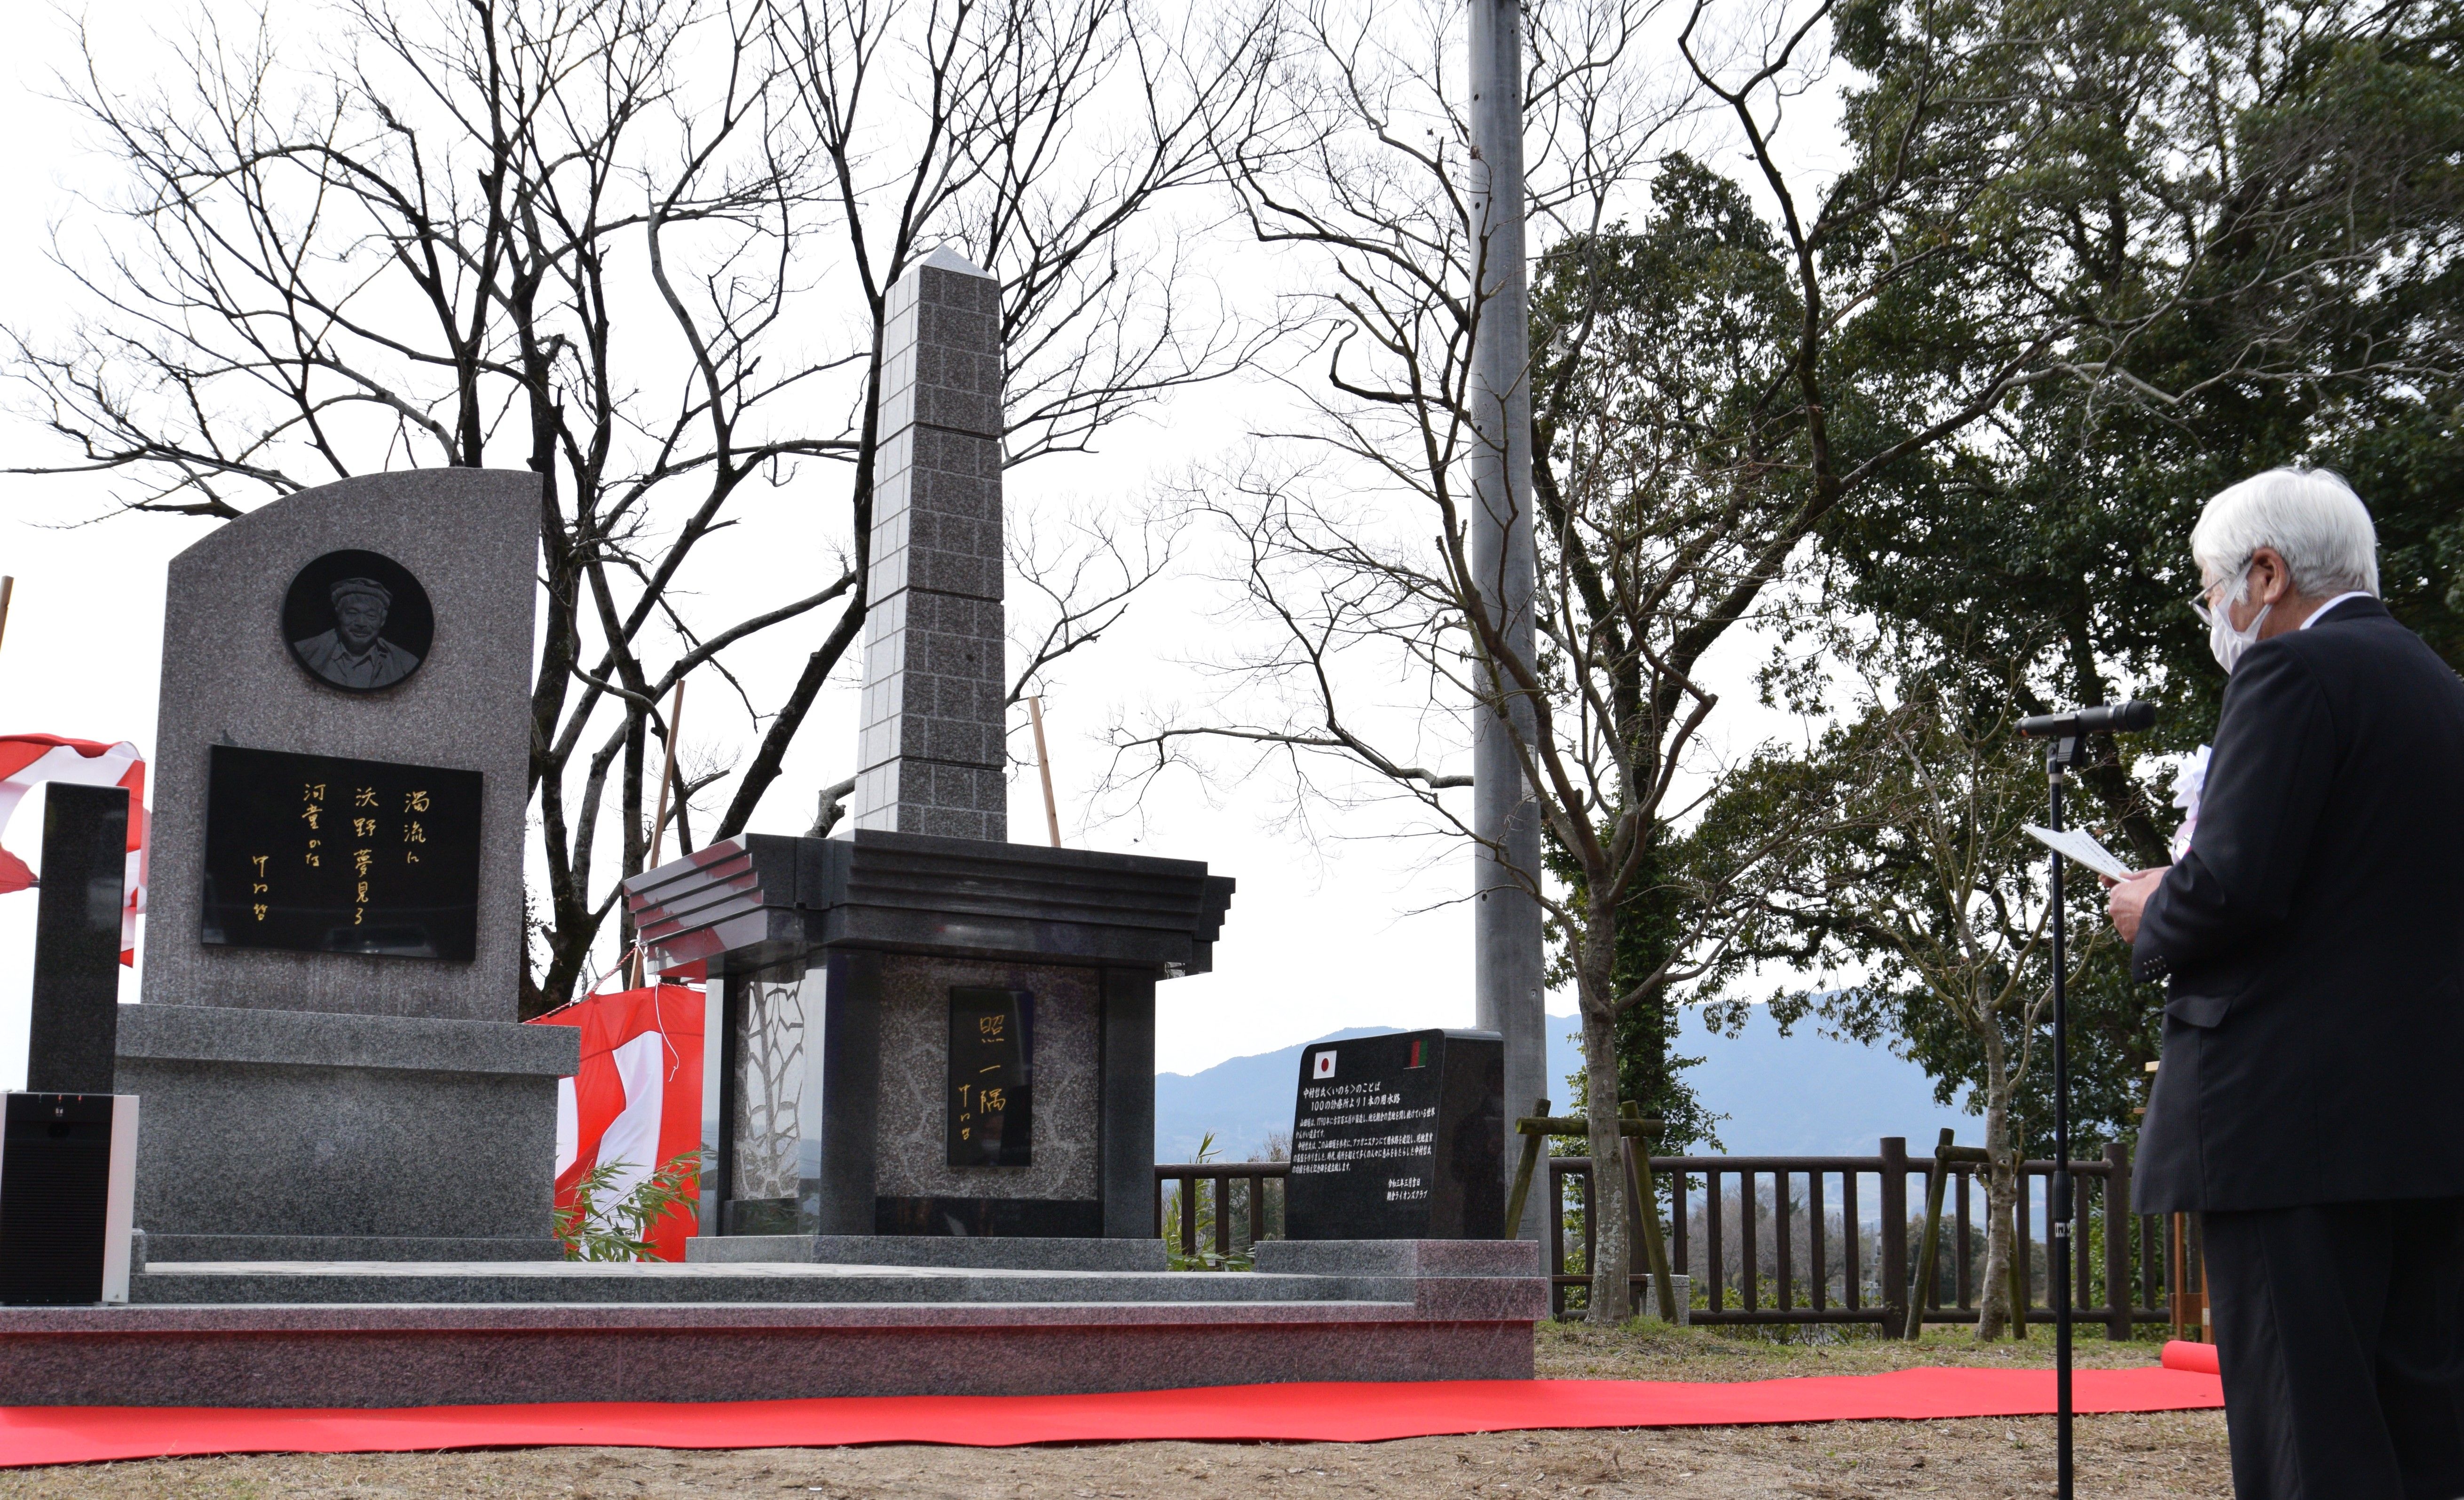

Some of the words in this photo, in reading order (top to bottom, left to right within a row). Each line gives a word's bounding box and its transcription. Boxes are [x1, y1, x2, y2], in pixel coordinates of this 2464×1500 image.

[301, 783, 326, 867] 河童かな
[403, 790, 430, 863] 濁流に
[979, 1015, 1006, 1114] 照一隅
[1387, 1190, 1428, 1201] 朝倉ライオンズクラブ
[1388, 1177, 1421, 1188] 令和三年三月吉日
